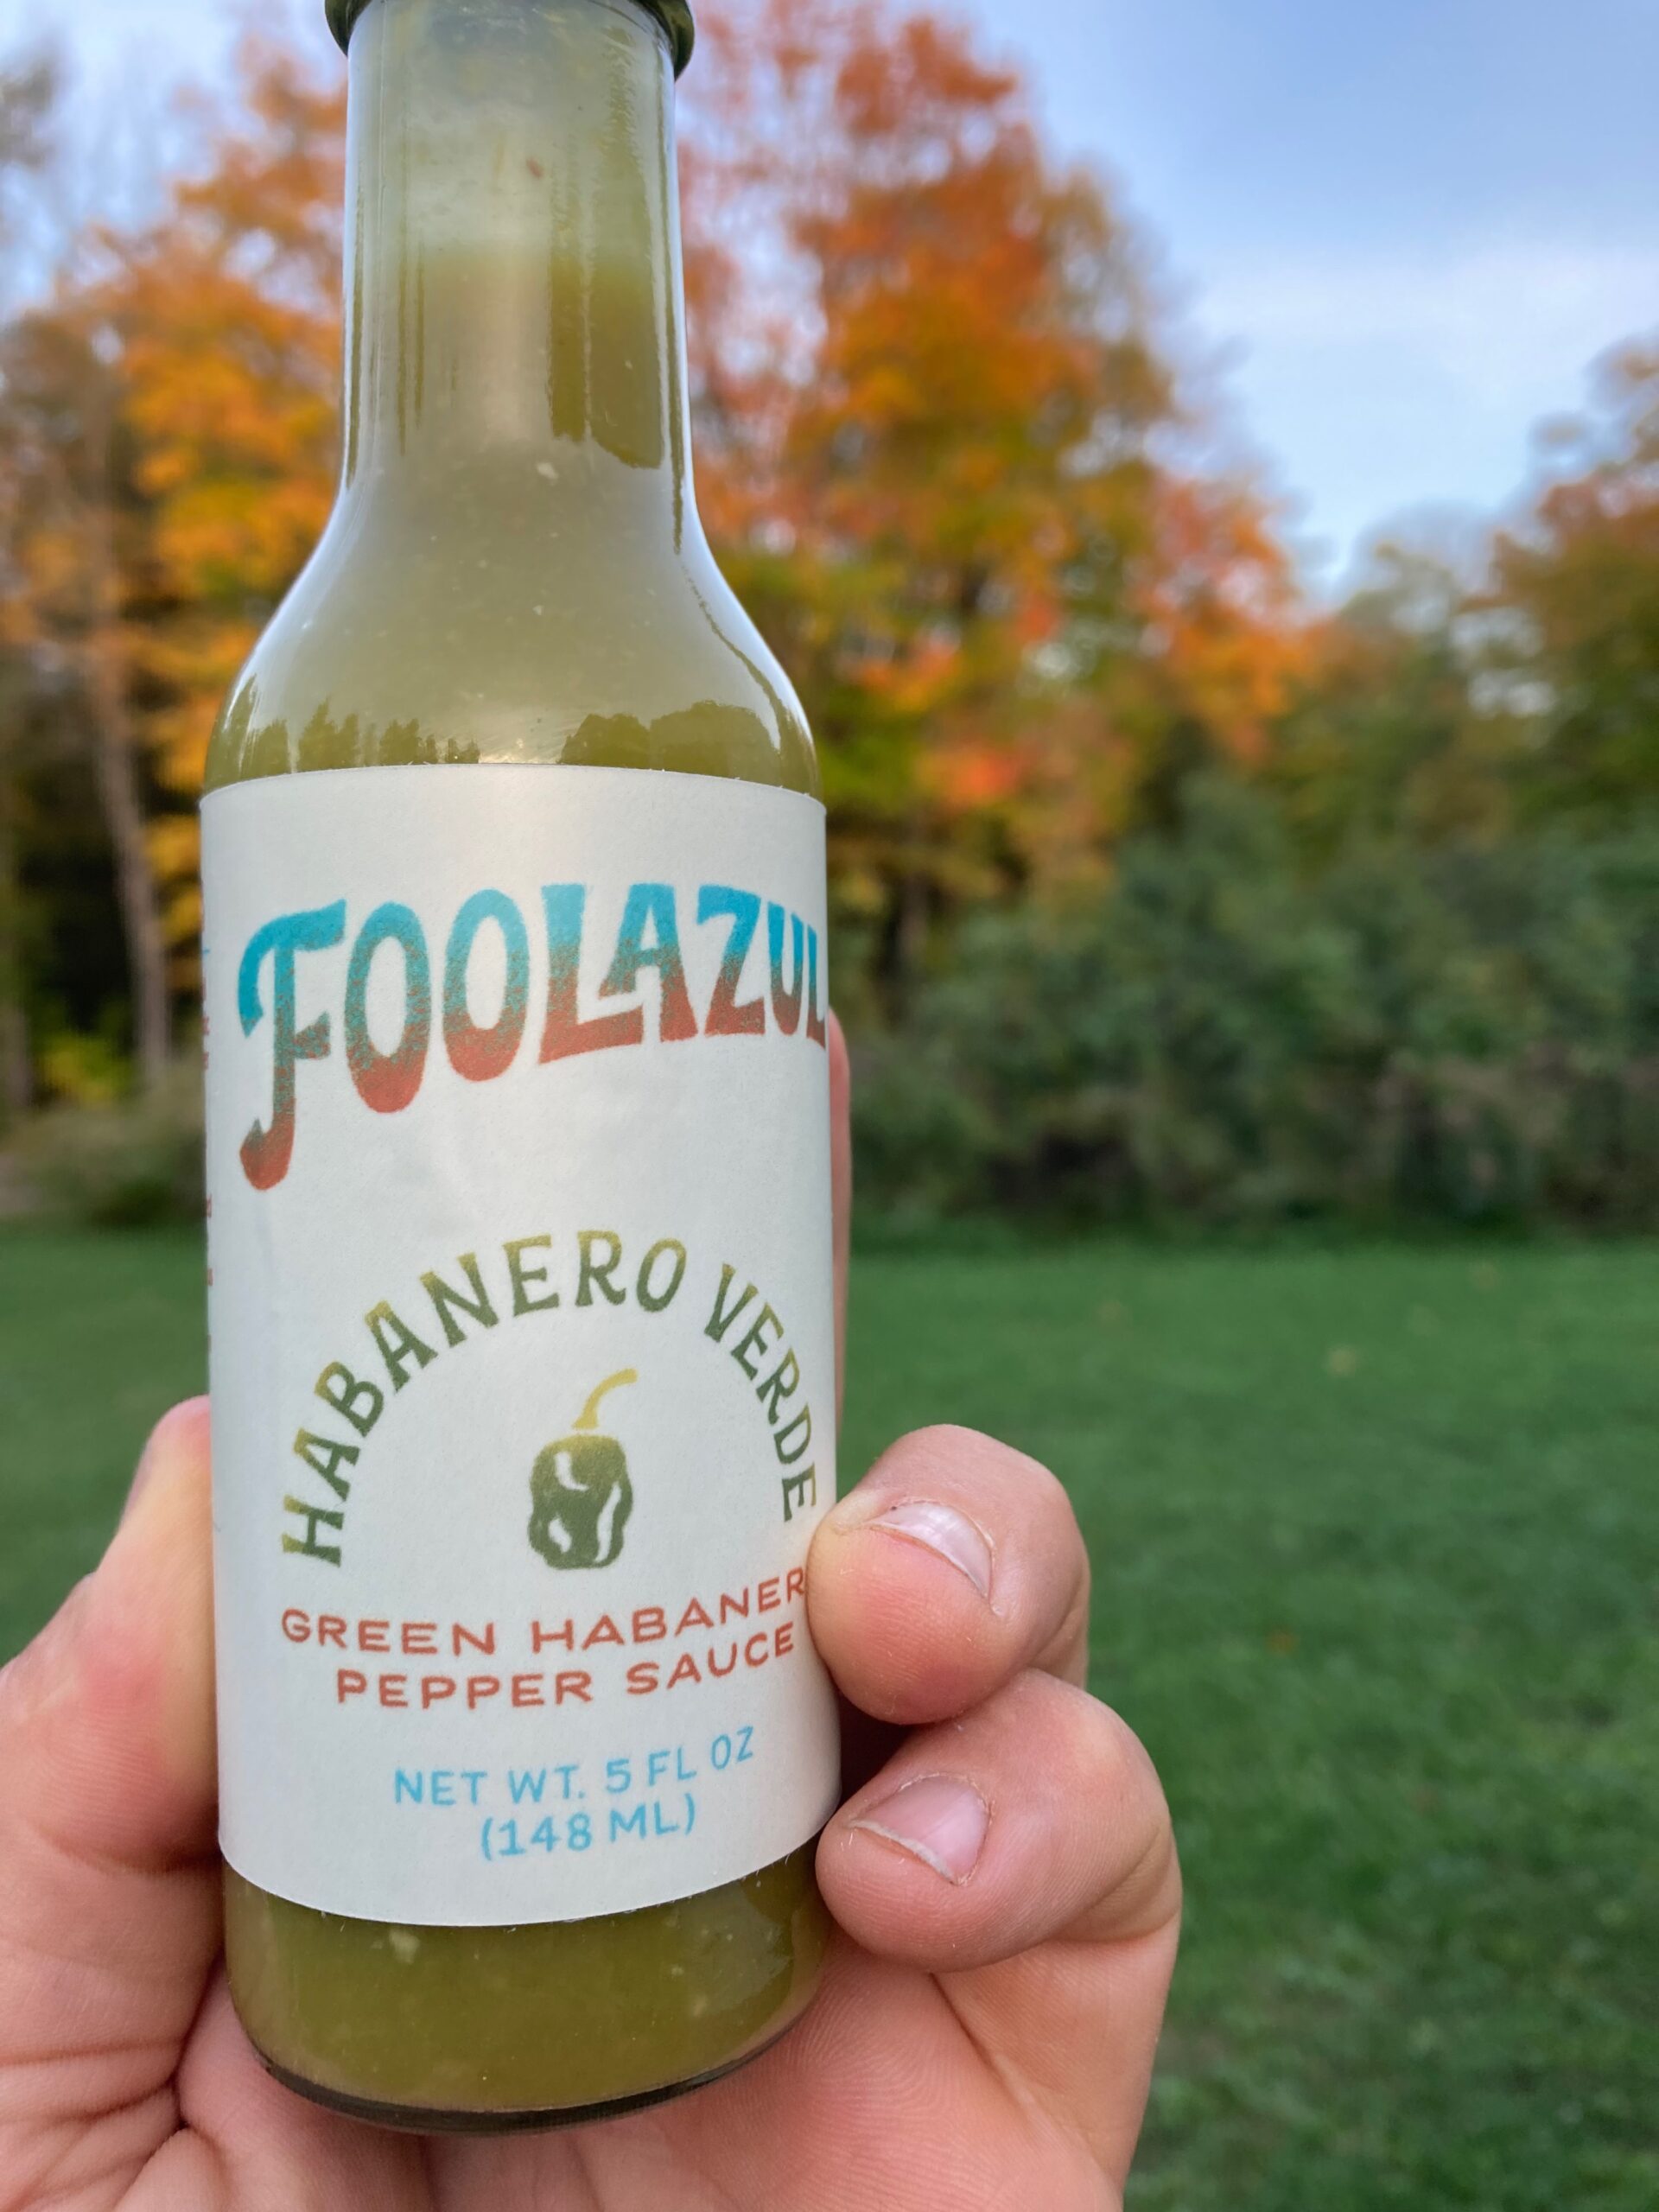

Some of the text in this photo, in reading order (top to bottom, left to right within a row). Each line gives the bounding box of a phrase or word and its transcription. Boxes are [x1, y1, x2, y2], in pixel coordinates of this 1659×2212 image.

[237, 881, 827, 1192] FOOLAZUL
[281, 1229, 817, 1568] HABANERO VERDE
[281, 1567, 806, 1657] GREEN HABANER
[336, 1620, 796, 1711] PEPPER SAUCE
[393, 1726, 754, 1807] NET WT. 5 FL OZ
[480, 1793, 696, 1861] (148 ML)
